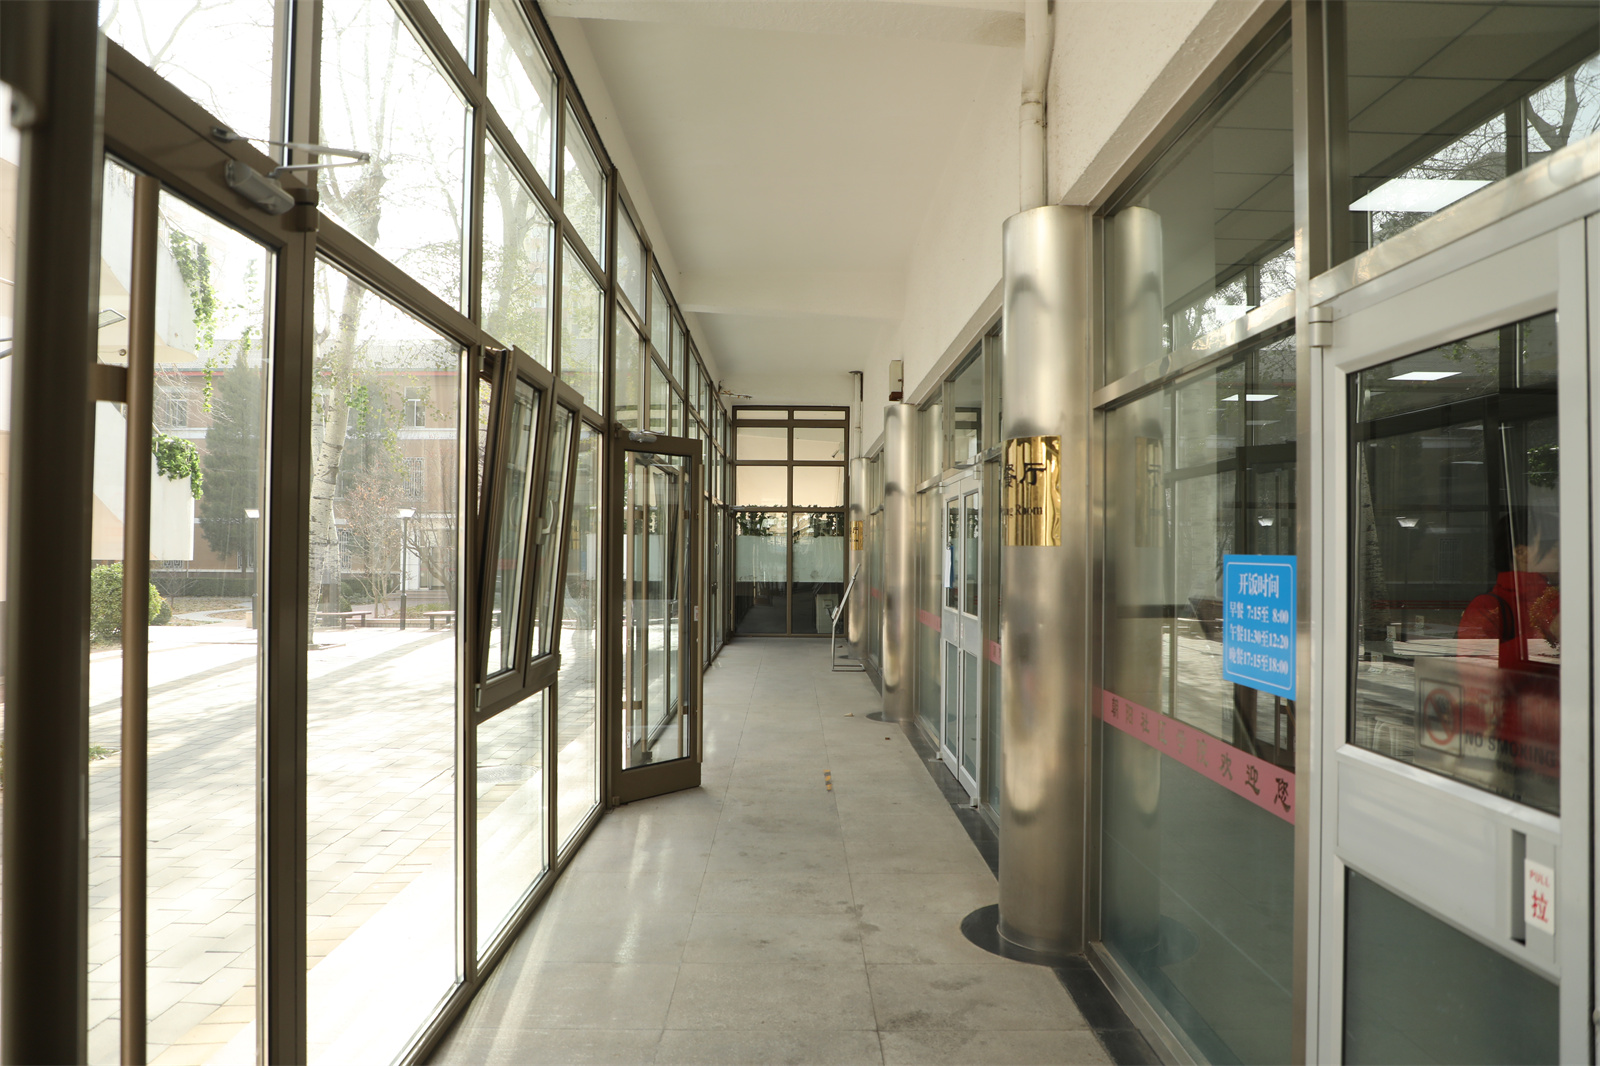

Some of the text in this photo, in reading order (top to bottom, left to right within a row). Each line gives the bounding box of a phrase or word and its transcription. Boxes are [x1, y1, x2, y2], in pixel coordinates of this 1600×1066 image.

[1016, 504, 1043, 515] Room
[1238, 573, 1280, 598] 开饭时间
[1465, 730, 1483, 748] NO
[1488, 735, 1556, 768] SMOKING
[1530, 869, 1550, 888] PULL
[1532, 889, 1549, 924] 拉
